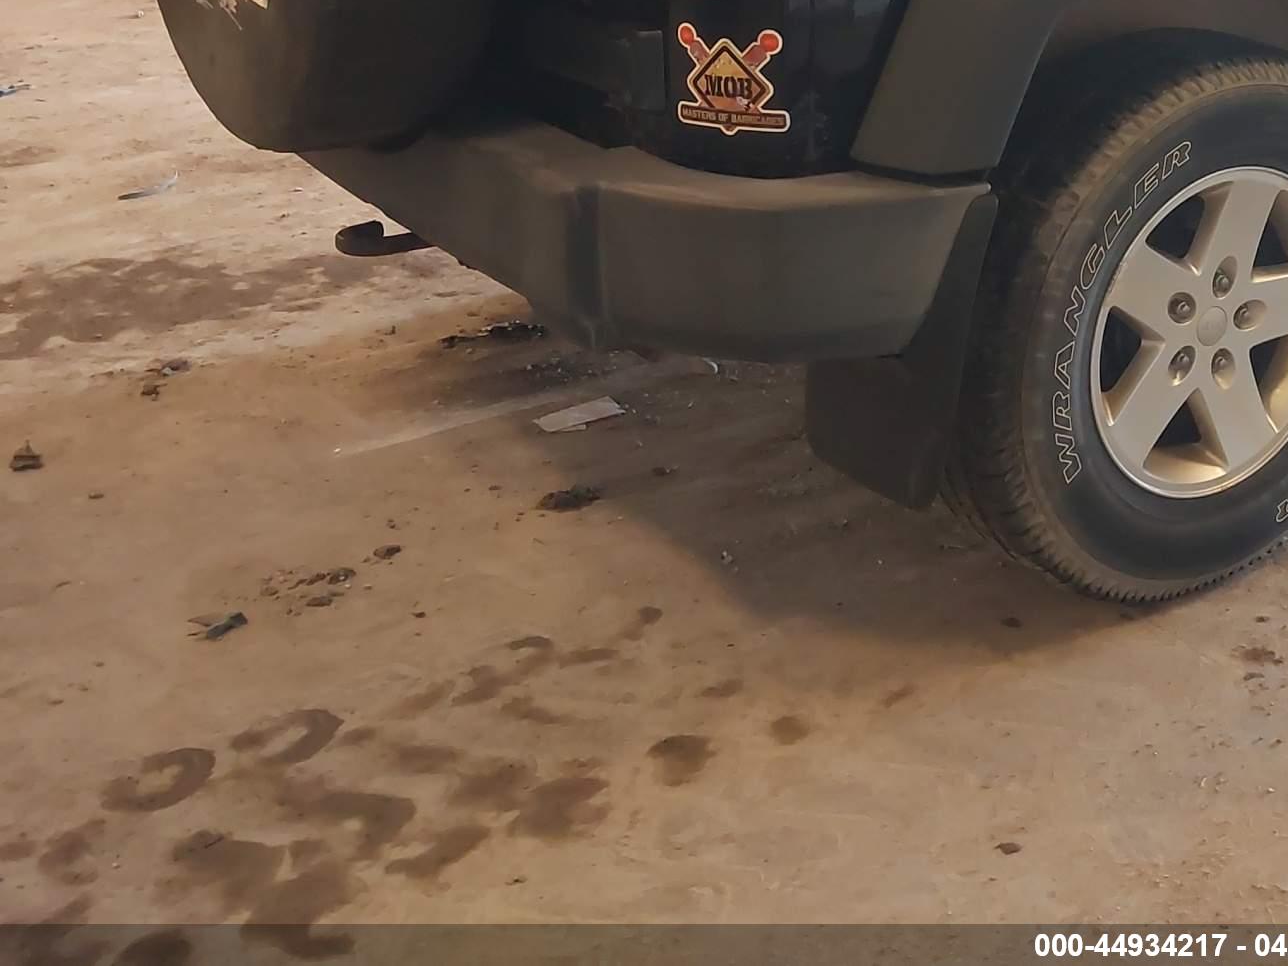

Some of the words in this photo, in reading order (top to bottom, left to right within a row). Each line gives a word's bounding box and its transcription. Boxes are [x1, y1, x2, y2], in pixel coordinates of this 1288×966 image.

[704, 74, 753, 100] MOB
[681, 106, 717, 122] MASTERS
[718, 113, 729, 123] OF
[1052, 141, 1192, 484] WRANGLER
